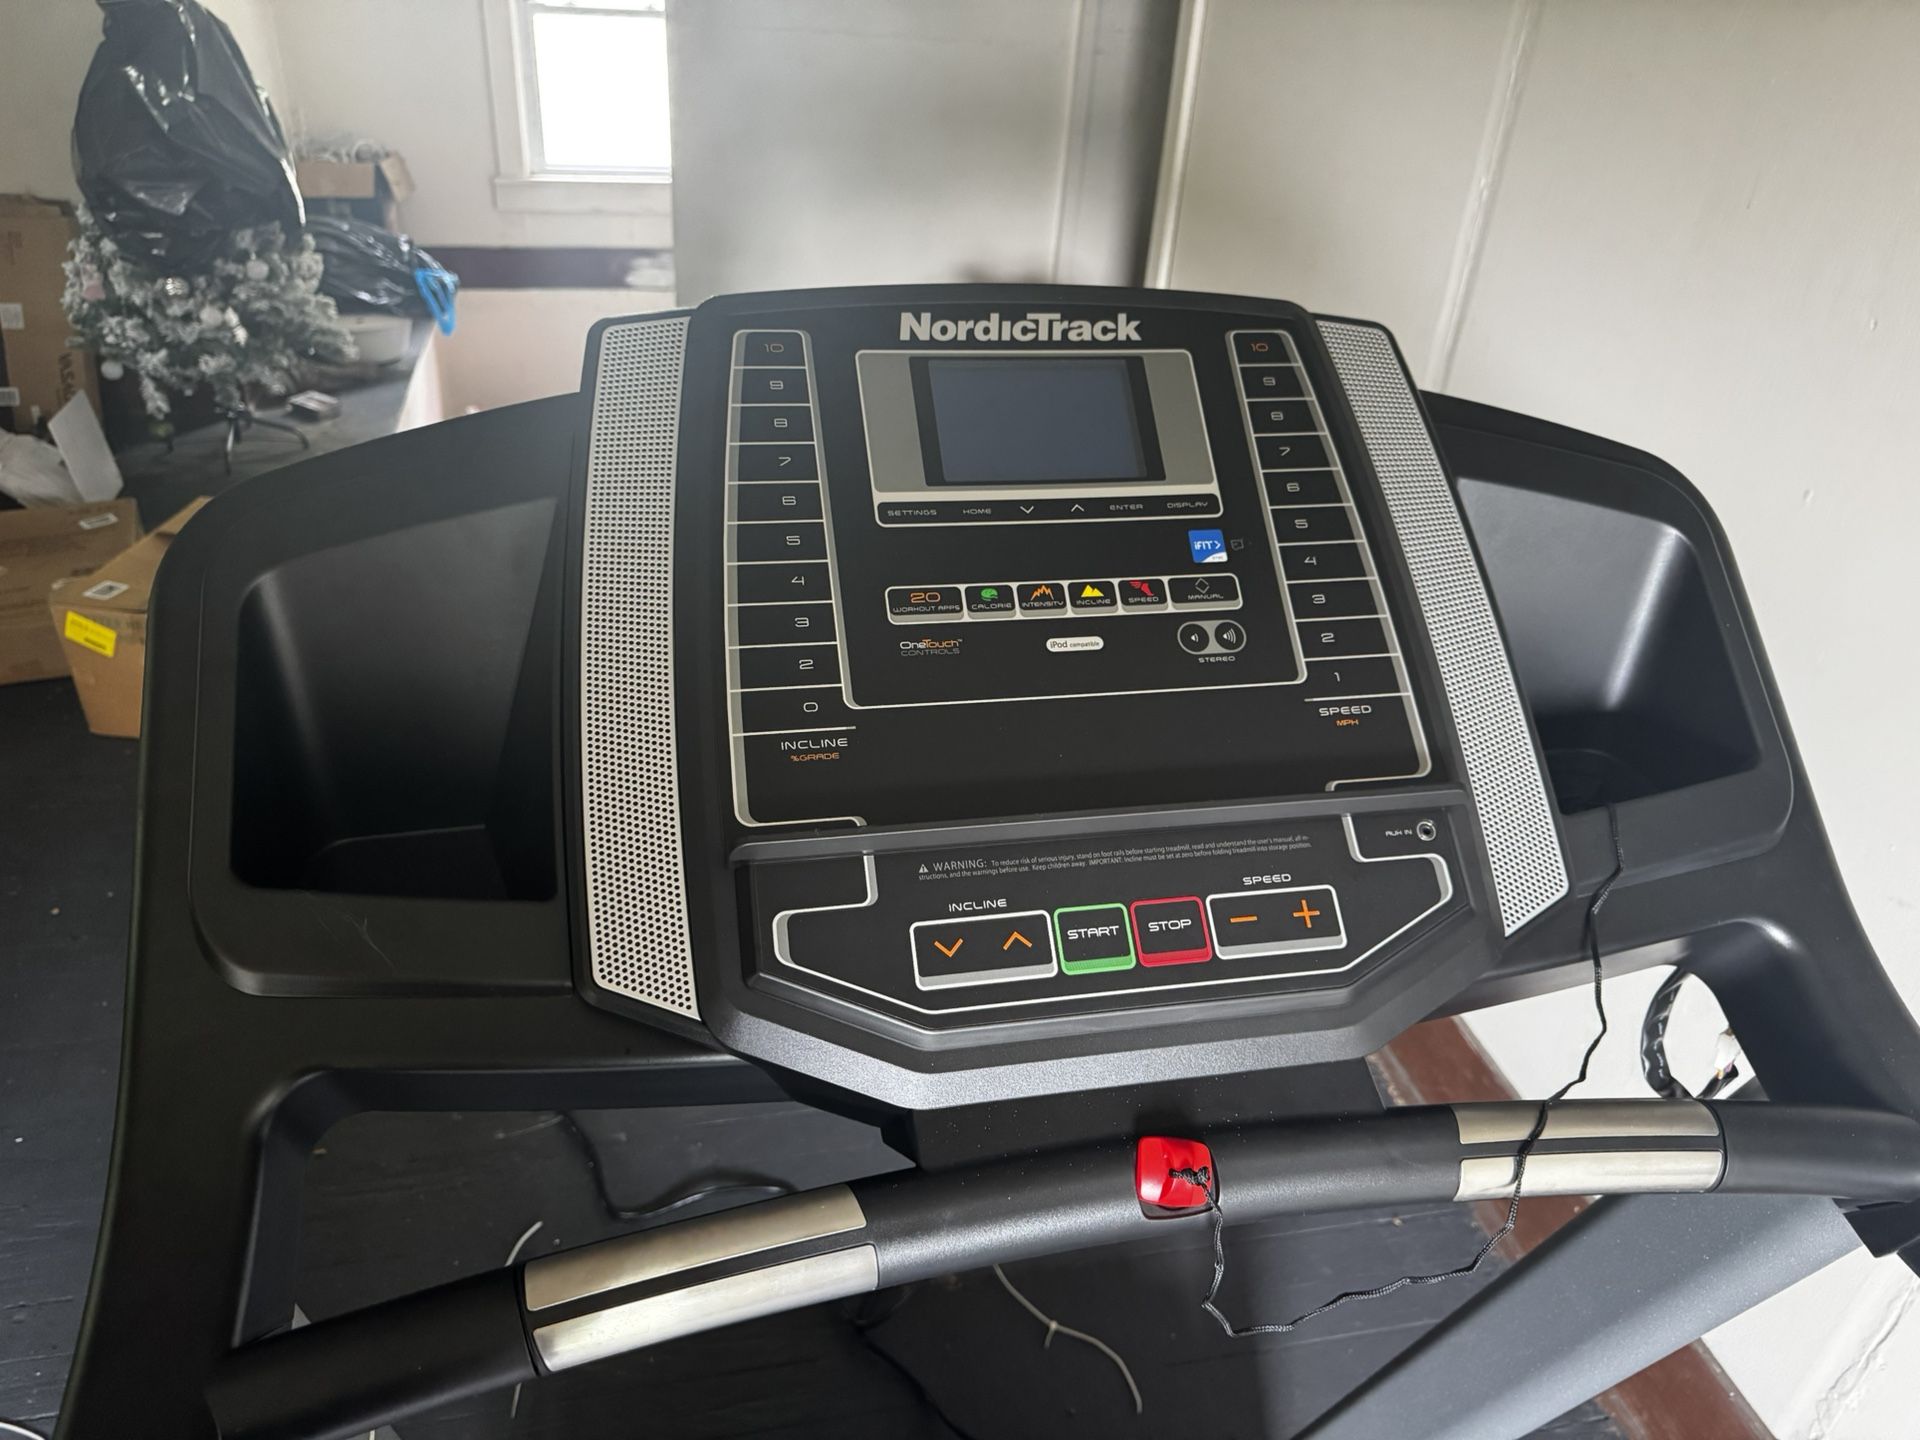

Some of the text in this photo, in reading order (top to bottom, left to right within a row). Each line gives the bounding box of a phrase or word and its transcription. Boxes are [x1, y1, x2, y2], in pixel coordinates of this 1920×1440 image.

[899, 312, 1143, 342] NordicTrack
[764, 343, 785, 353] 10
[1250, 343, 1269, 352] 10
[769, 380, 784, 390] 9
[1263, 376, 1277, 386] 9
[1270, 411, 1284, 421] 8
[773, 418, 788, 428] 8
[1279, 447, 1291, 456] 7
[778, 456, 792, 466] 7
[1286, 482, 1300, 492] 6
[782, 496, 797, 506] 6
[1166, 501, 1209, 510] DISPLAY
[962, 508, 992, 516] HOME
[1109, 503, 1144, 512] ENTER
[887, 509, 937, 517] SETTINGS
[1294, 519, 1309, 529] 5
[785, 535, 801, 546] 5
[1304, 556, 1317, 566] 4
[791, 576, 805, 586] 4
[910, 592, 941, 604] 20
[1076, 598, 1111, 606] INCLINE
[1187, 593, 1224, 601] MANUAL
[1311, 594, 1326, 604] 3
[892, 604, 961, 614] WORKOUT APPS
[971, 602, 1013, 610] CALORIE
[1021, 600, 1064, 608] INTENSITY
[794, 617, 810, 628] 3
[1320, 632, 1336, 643] 2
[1050, 640, 1100, 650] iPod compatible
[900, 648, 961, 657] CONTROLS
[798, 659, 814, 670] 2
[1198, 656, 1236, 664] STEREO
[1333, 672, 1341, 682] 1
[803, 702, 819, 713] 0
[1318, 705, 1372, 717] SPEED
[1336, 719, 1360, 727] MPH
[780, 738, 848, 751] INCLINE
[790, 752, 840, 762] %GRADE
[932, 858, 988, 872] WARNING:
[992, 859, 999, 868] To
[999, 858, 1020, 867] reduce
[1020, 857, 1031, 865] risk
[1038, 855, 1058, 863] serious
[1125, 848, 1143, 856] before
[1144, 846, 1165, 855] starting
[1216, 840, 1247, 849] understand
[1247, 838, 1257, 846] the
[949, 870, 961, 878] and
[961, 869, 972, 877] the
[972, 867, 998, 876] warnings
[999, 866, 1018, 874] before
[1032, 863, 1046, 871] Keep
[1047, 861, 1071, 869] children
[1165, 852, 1174, 860] set
[1194, 849, 1212, 857] before
[1212, 847, 1232, 856] folding
[1232, 845, 1256, 854] treadmill
[1256, 844, 1268, 852] into
[1268, 844, 1288, 852] storage
[1242, 873, 1292, 886] SPEED
[948, 897, 1008, 913] INCLINE
[1147, 918, 1193, 933] STOP
[1067, 924, 1120, 941] START
